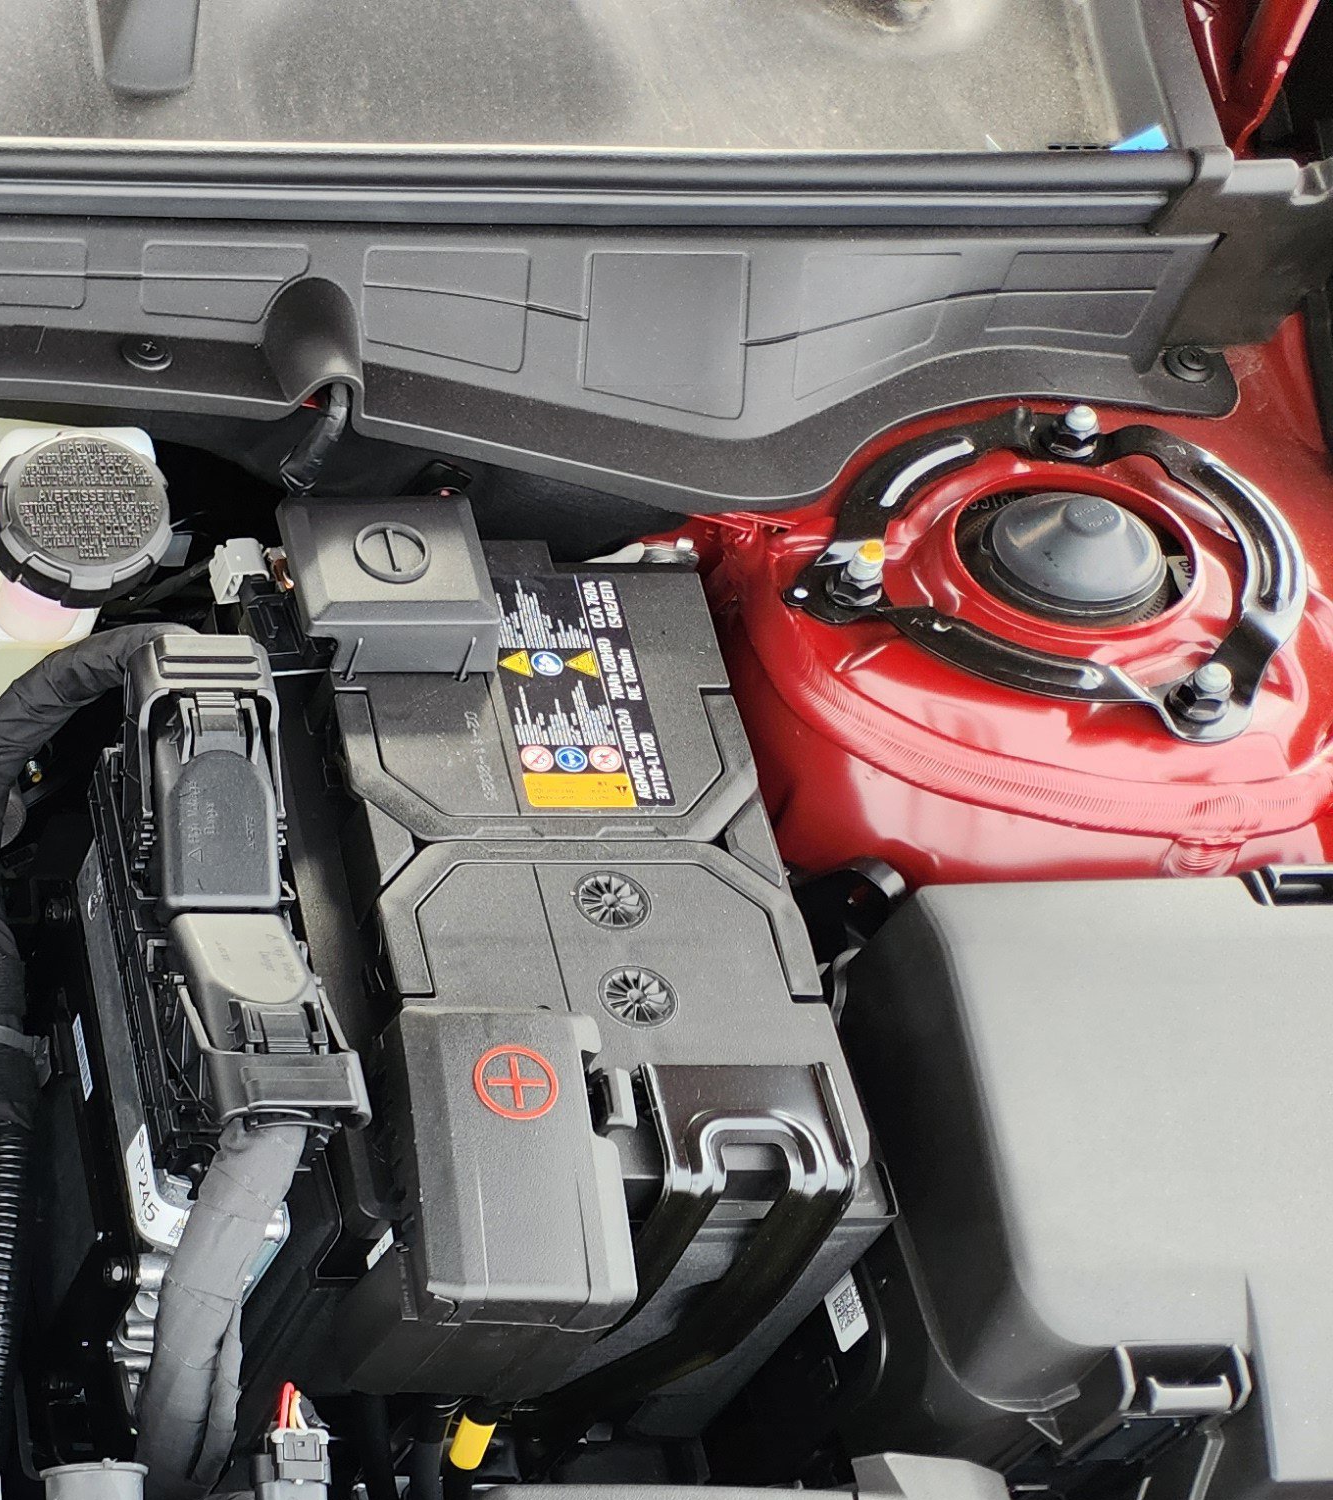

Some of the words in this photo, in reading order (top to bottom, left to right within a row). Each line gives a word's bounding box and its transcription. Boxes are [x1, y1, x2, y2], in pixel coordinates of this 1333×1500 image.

[99, 463, 122, 475] DOT
[38, 489, 136, 502] AVERTISSEMENT
[105, 523, 127, 535] DOT
[582, 581, 601, 606] 760A
[588, 606, 606, 629] CCA
[608, 673, 625, 700] 70Ah
[136, 1154, 161, 1223] P245
